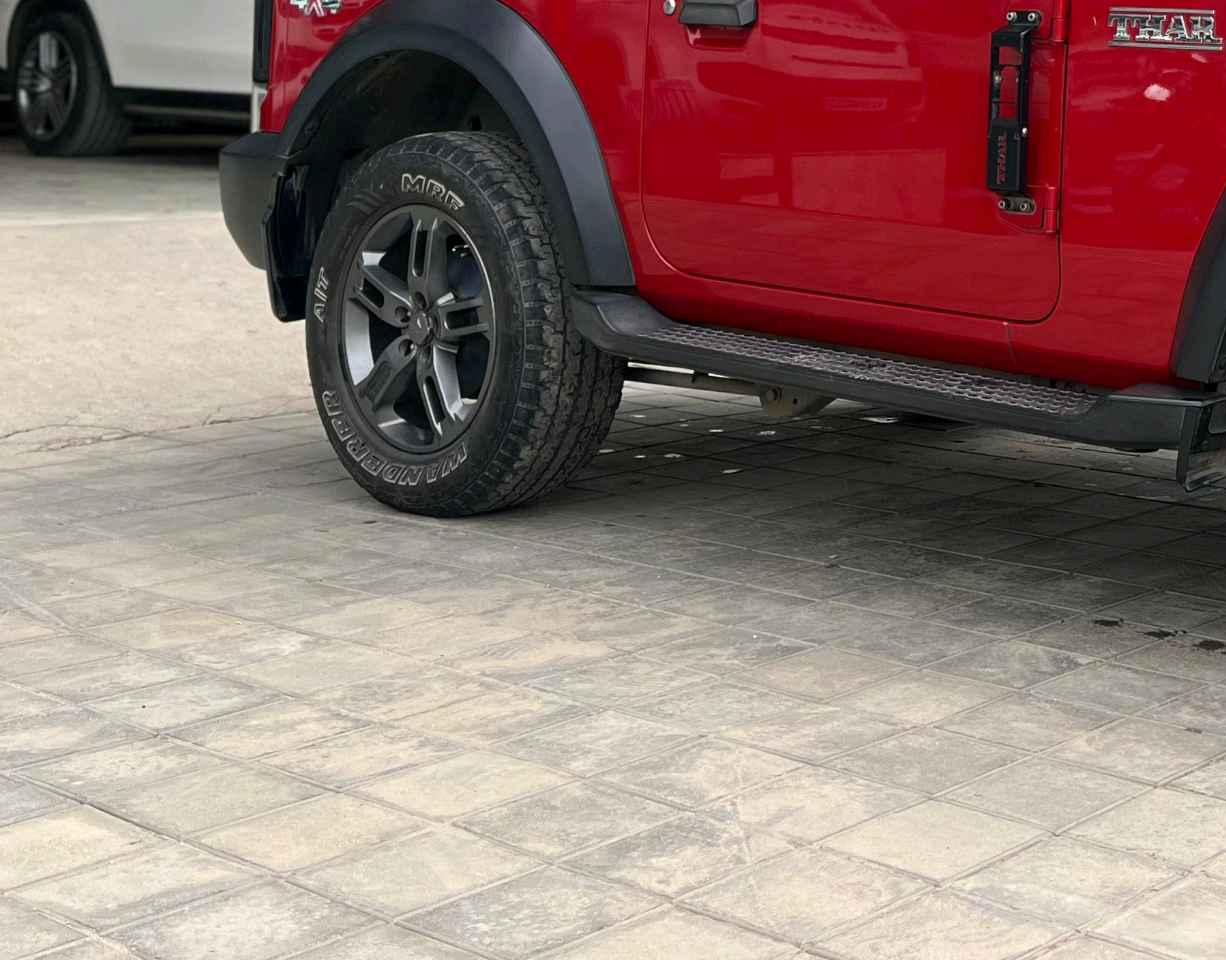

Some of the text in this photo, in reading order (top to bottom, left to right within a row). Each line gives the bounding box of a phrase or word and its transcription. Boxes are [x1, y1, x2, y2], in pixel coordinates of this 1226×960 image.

[1107, 12, 1224, 45] THAR
[402, 173, 465, 211] MRF
[321, 390, 468, 486] WANDERER
